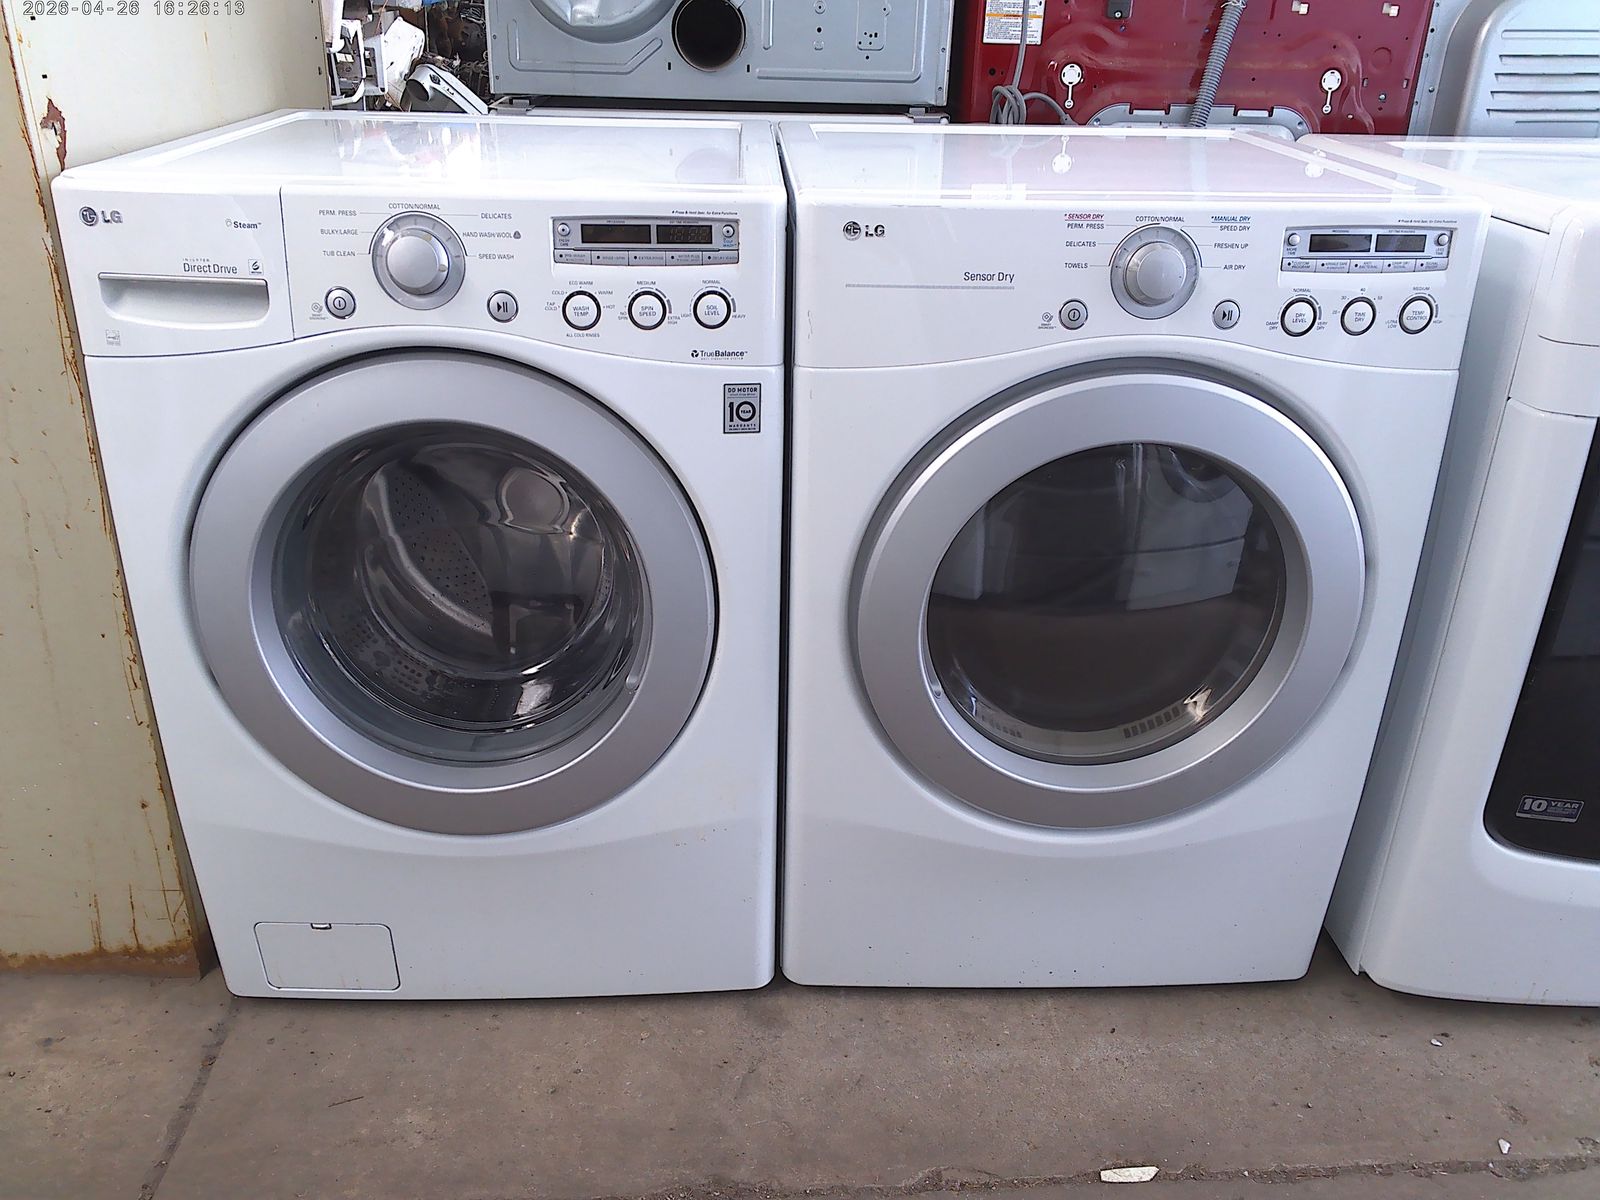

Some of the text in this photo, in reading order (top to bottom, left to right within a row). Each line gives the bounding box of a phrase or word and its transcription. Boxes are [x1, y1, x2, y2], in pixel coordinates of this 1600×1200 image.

[101, 210, 123, 224] LG
[864, 224, 886, 238] LG
[183, 263, 237, 274] Direct Drive
[963, 271, 1015, 283] Sensor Dry
[728, 401, 756, 422] 10
[1523, 798, 1548, 812] 10
[1550, 801, 1579, 809] YEAR
